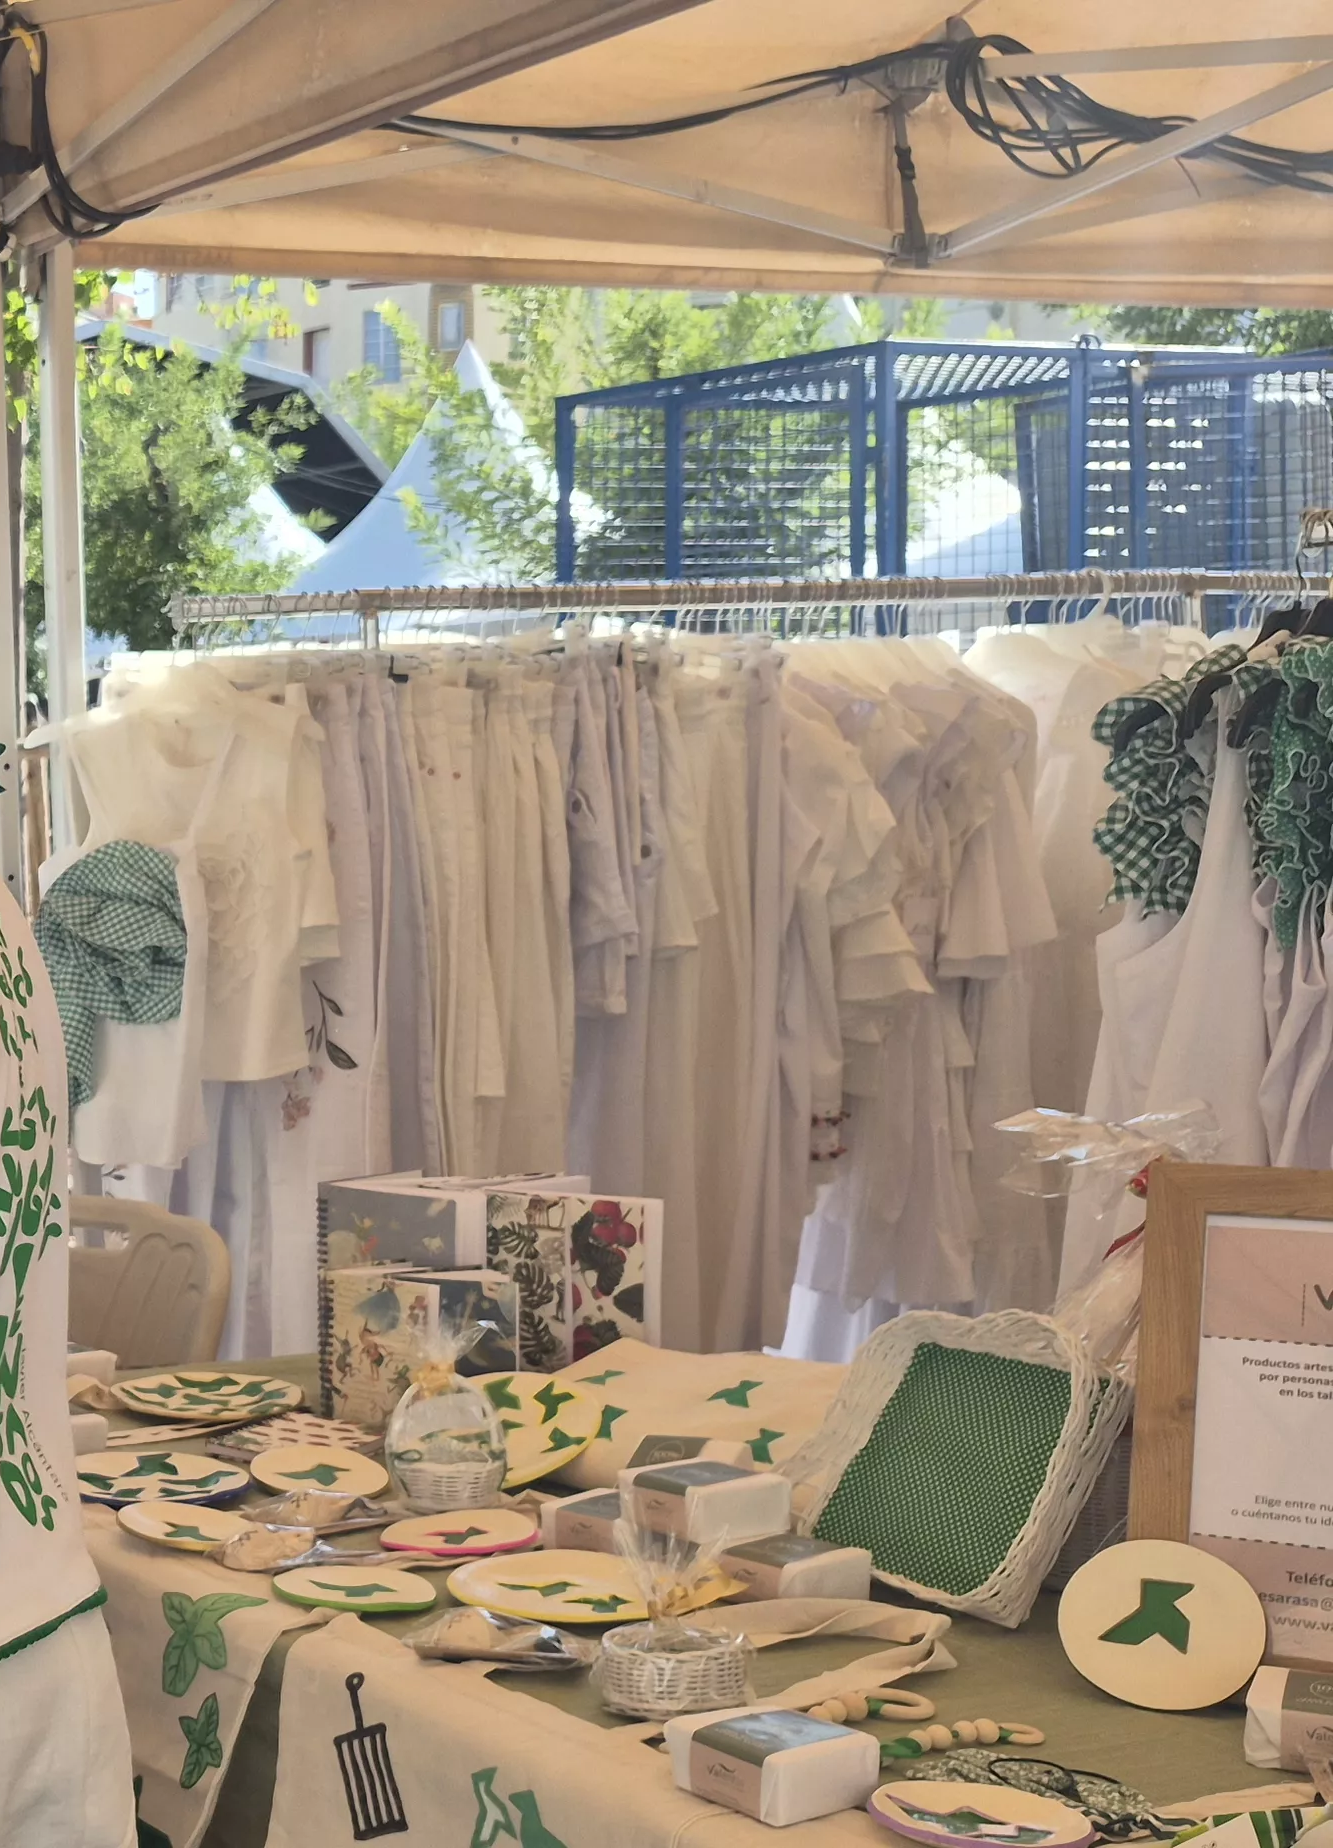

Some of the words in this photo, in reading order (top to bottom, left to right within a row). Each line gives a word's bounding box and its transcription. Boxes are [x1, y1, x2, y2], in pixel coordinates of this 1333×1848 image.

[1242, 1355, 1301, 1370] Productos
[1259, 1373, 1279, 1382] por
[1279, 1388, 1294, 1397] en
[1297, 1388, 1314, 1398] los
[1255, 1495, 1282, 1507] Elige
[1284, 1500, 1316, 1510] entre
[1230, 1508, 1239, 1516] o
[1241, 1509, 1302, 1523] cuéntanos
[1305, 1516, 1317, 1524] tu
[1286, 1571, 1333, 1588] Teléfo
